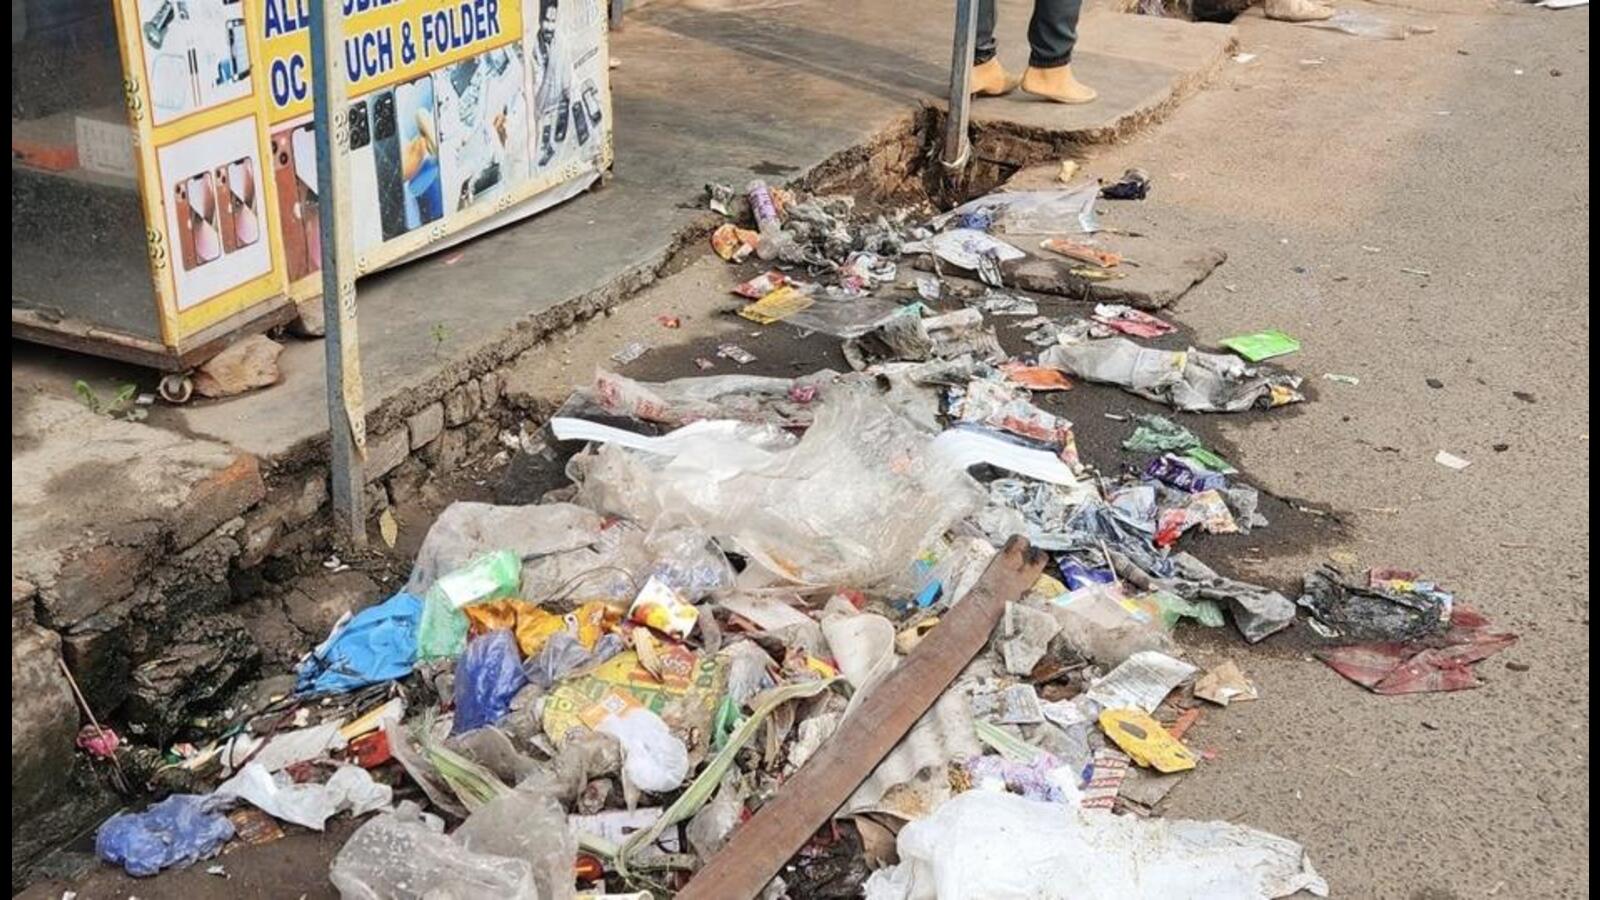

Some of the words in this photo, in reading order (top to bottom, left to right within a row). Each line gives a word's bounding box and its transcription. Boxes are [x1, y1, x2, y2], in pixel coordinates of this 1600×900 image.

[344, 28, 393, 82] UCH
[402, 21, 416, 64] &
[421, 0, 500, 58] FOLDER
